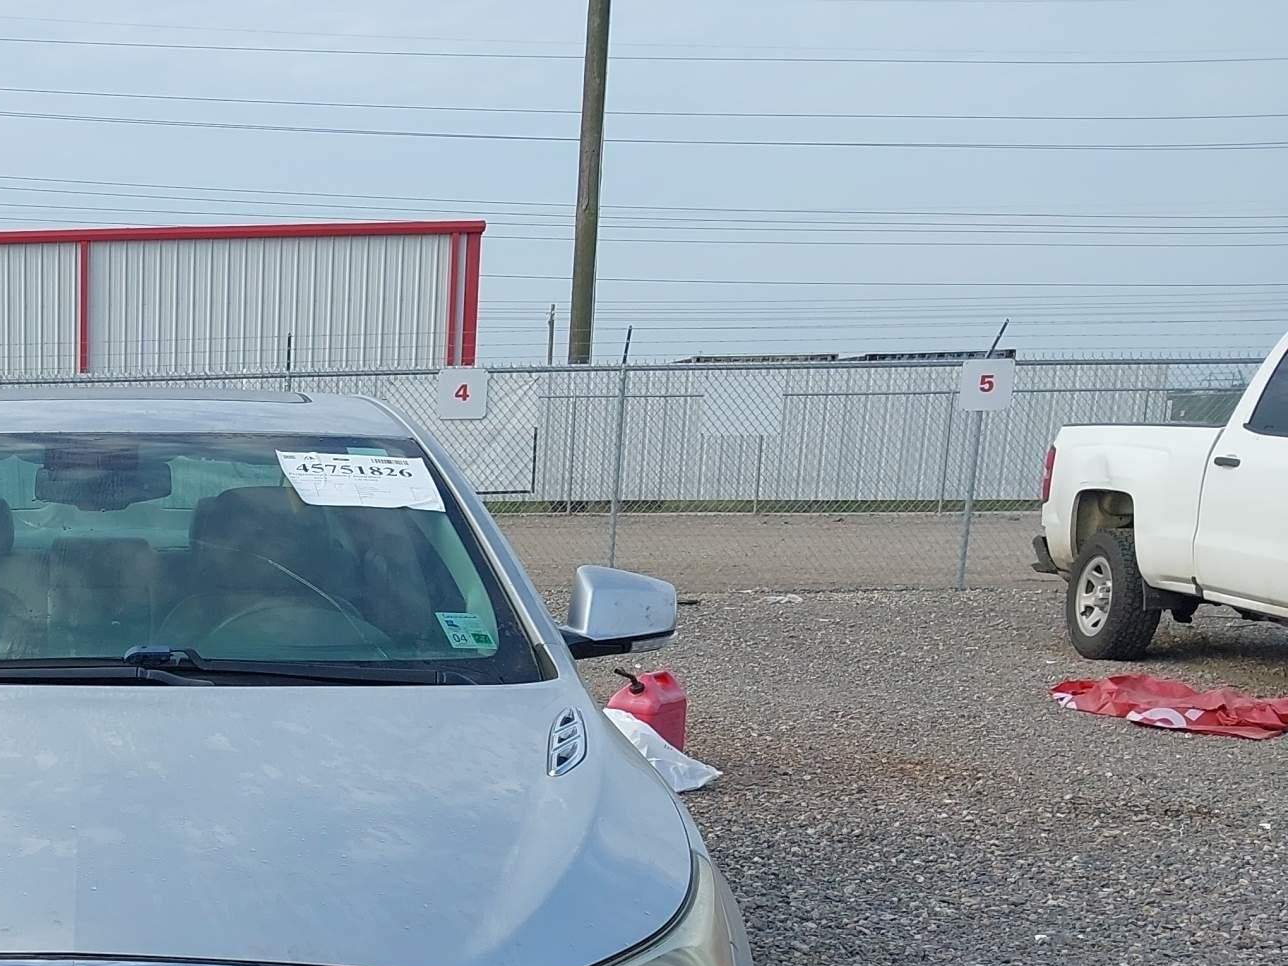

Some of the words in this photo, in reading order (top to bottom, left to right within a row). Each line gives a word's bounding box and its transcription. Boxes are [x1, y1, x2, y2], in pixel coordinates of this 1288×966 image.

[454, 383, 470, 401] 4
[979, 374, 994, 393] 5
[296, 463, 413, 478] 45751826
